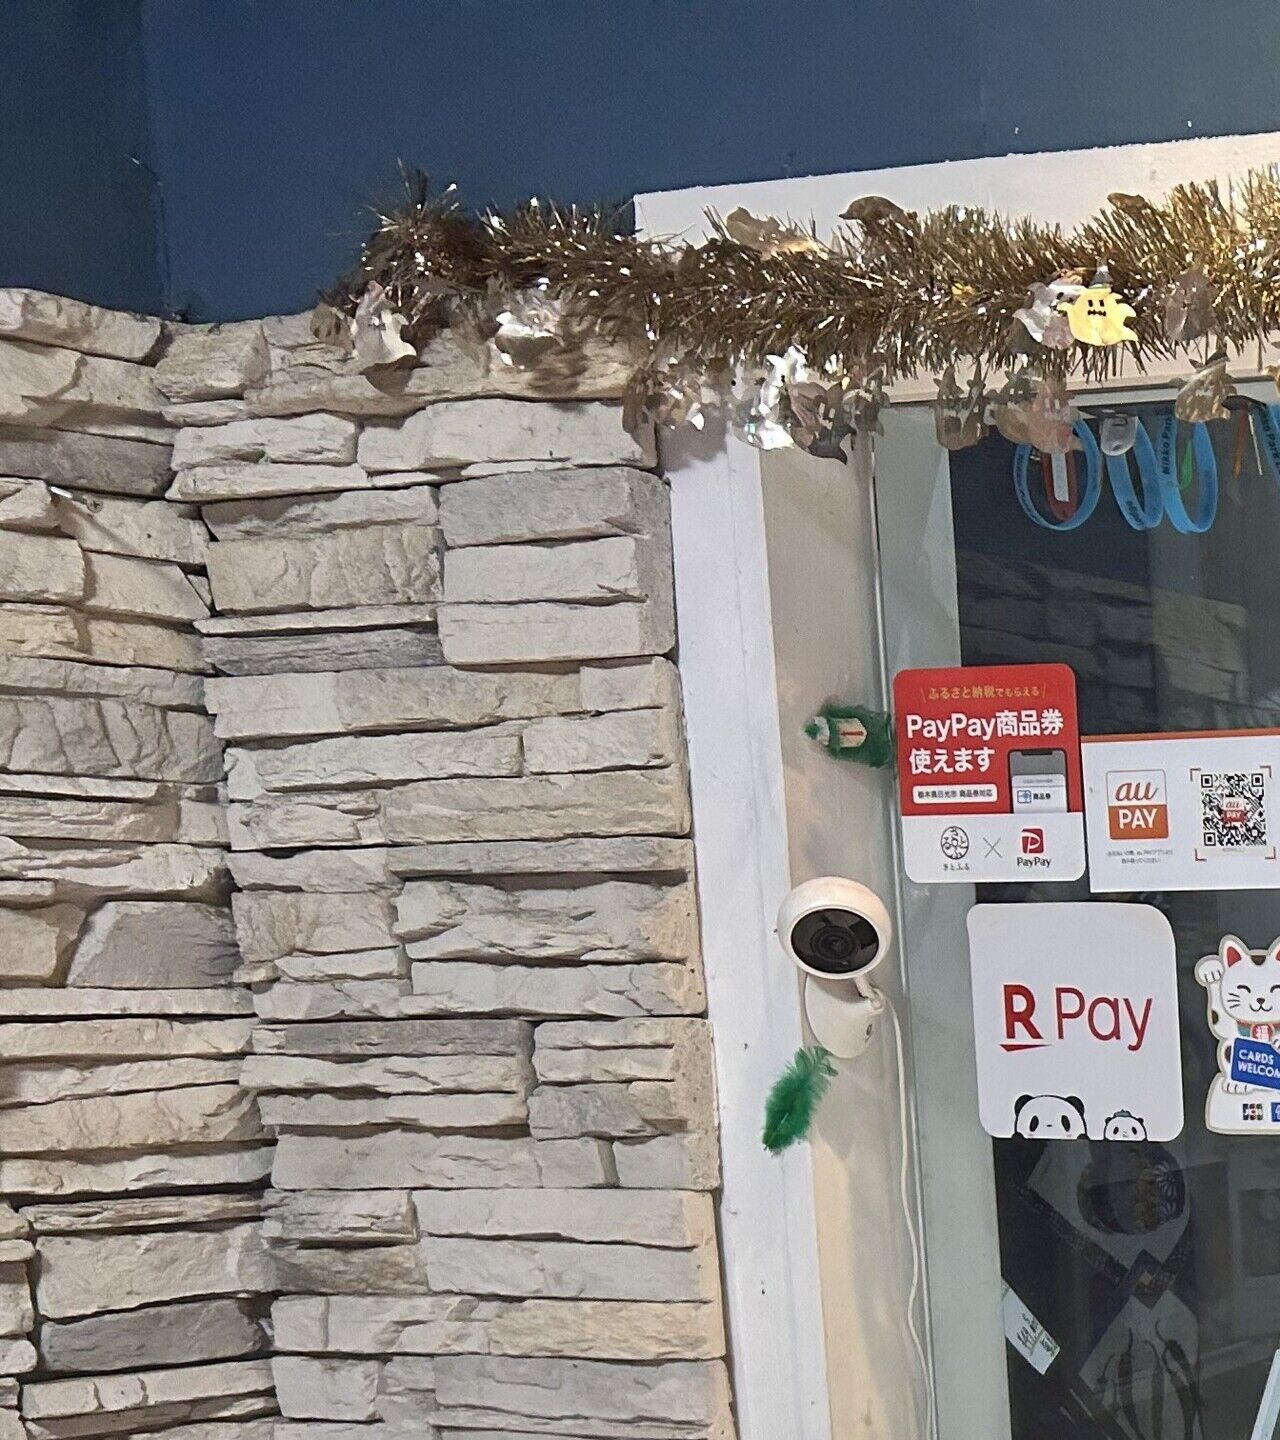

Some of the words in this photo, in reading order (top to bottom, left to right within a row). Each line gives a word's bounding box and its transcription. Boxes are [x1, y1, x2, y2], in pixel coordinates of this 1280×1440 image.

[906, 708, 1064, 742] PayPay商品券
[909, 746, 996, 774] 使えます
[1115, 781, 1159, 802] au
[1118, 808, 1157, 830] PAY
[1016, 857, 1052, 868] PayPay
[1002, 984, 1044, 1042] R
[1056, 986, 1153, 1051] Pay
[1238, 1049, 1275, 1065] CARDS
